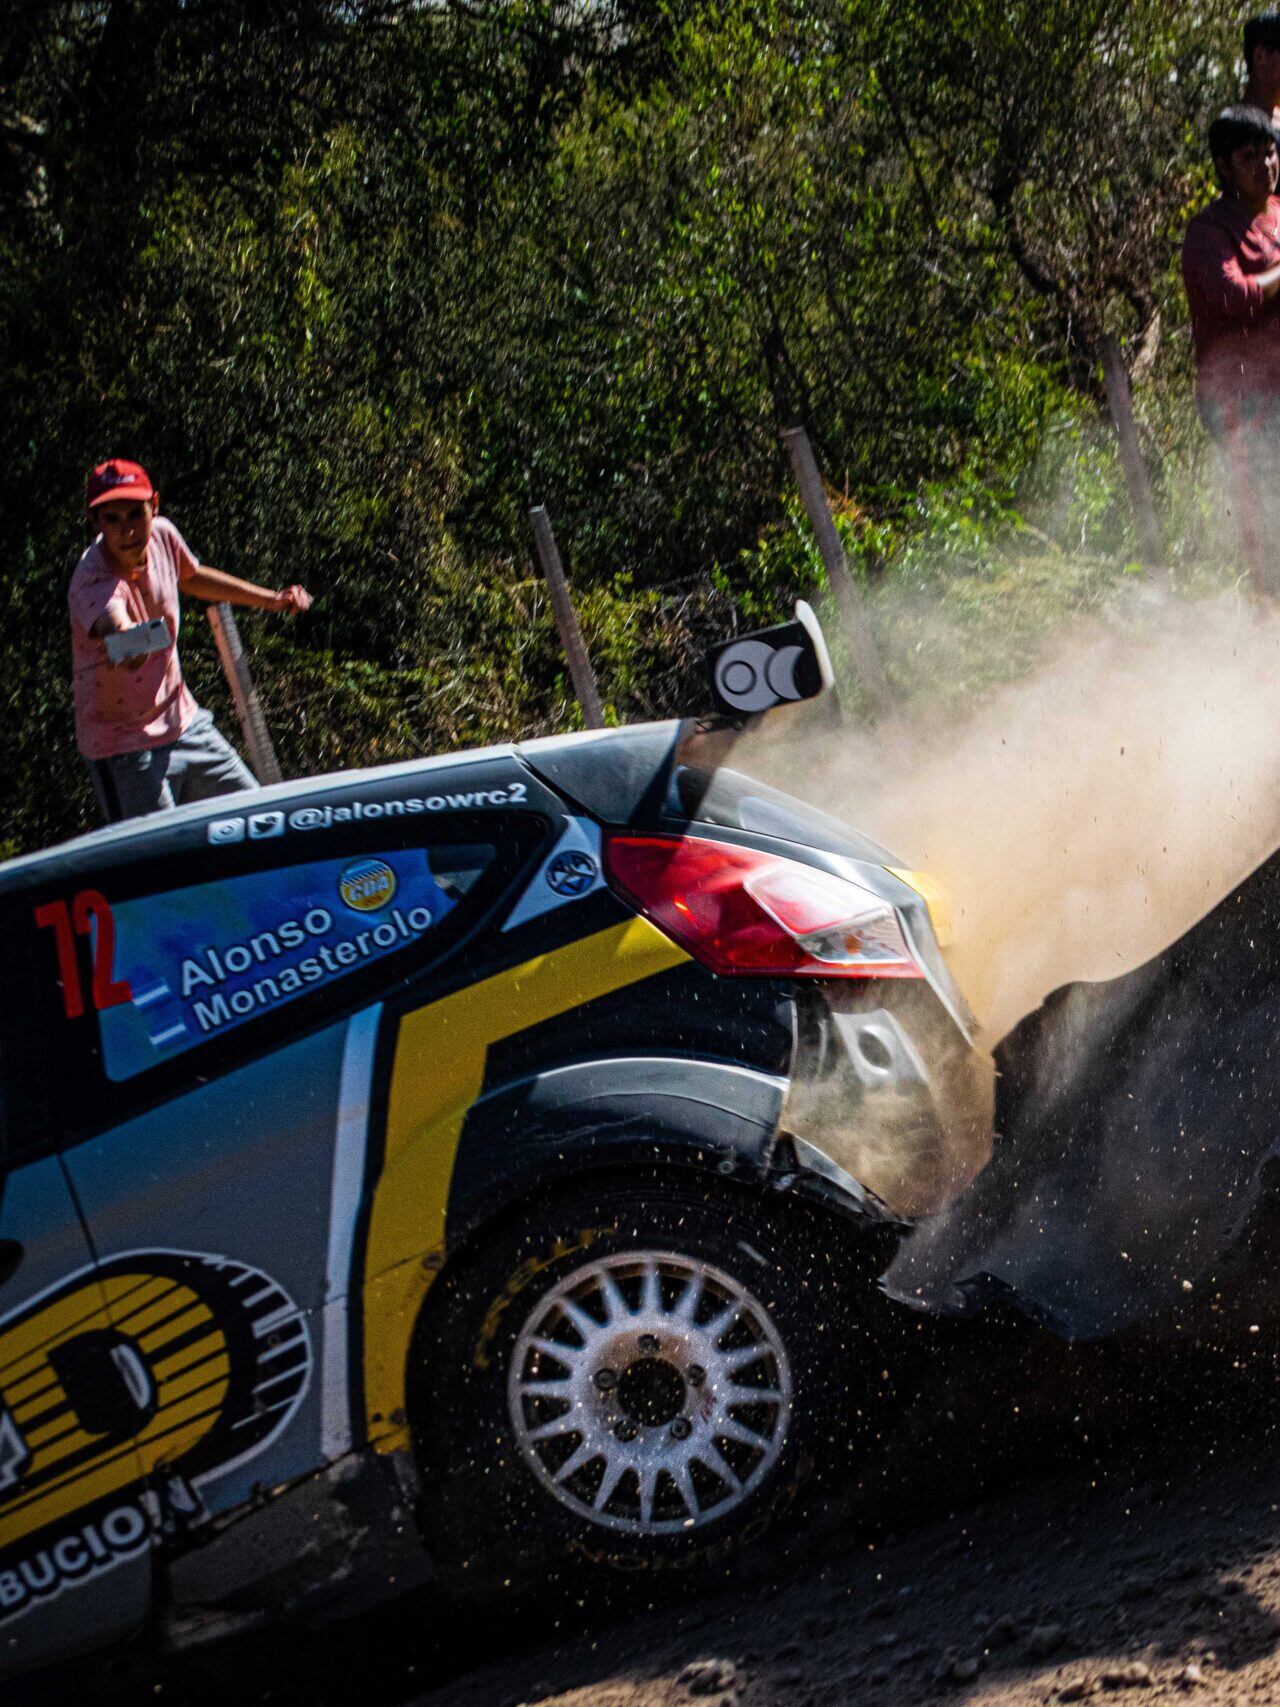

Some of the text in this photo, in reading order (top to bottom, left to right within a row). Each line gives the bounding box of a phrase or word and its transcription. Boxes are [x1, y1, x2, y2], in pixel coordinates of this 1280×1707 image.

[288, 782, 528, 831] @jalonsowrc2
[34, 889, 133, 1019] 12
[182, 908, 332, 997] Alonso
[193, 907, 432, 1031] Monasterolo
